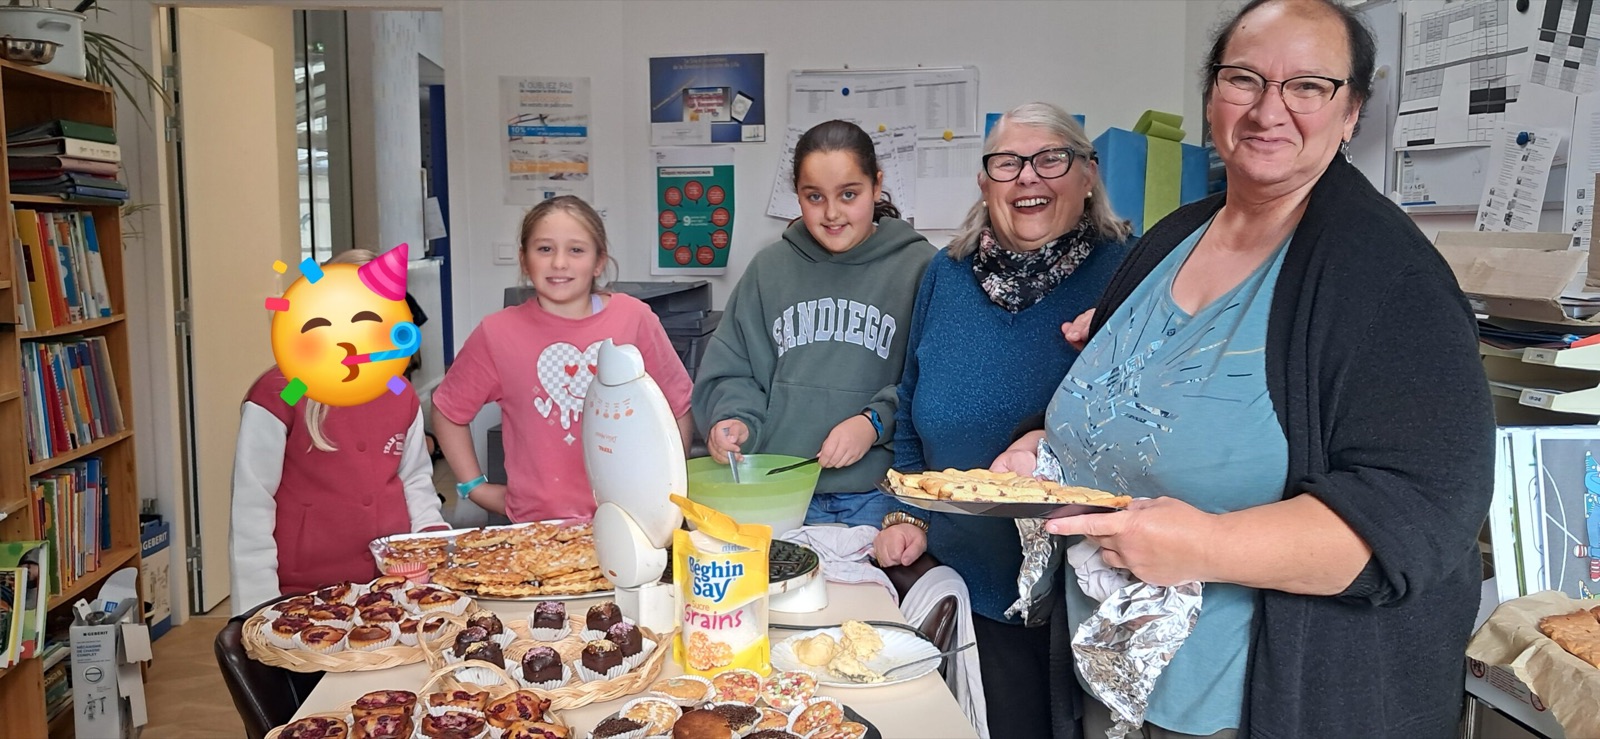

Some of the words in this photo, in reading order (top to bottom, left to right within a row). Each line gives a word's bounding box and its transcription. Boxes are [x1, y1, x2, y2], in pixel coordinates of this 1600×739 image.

[560, 82, 574, 90] PAS
[683, 215, 691, 226] 9
[772, 297, 896, 359] SANDIEGO
[142, 531, 168, 550] GEBERIT
[688, 556, 744, 582] Béghin
[693, 576, 732, 603] Say
[684, 603, 744, 630] Grains
[691, 601, 710, 611] Sucre
